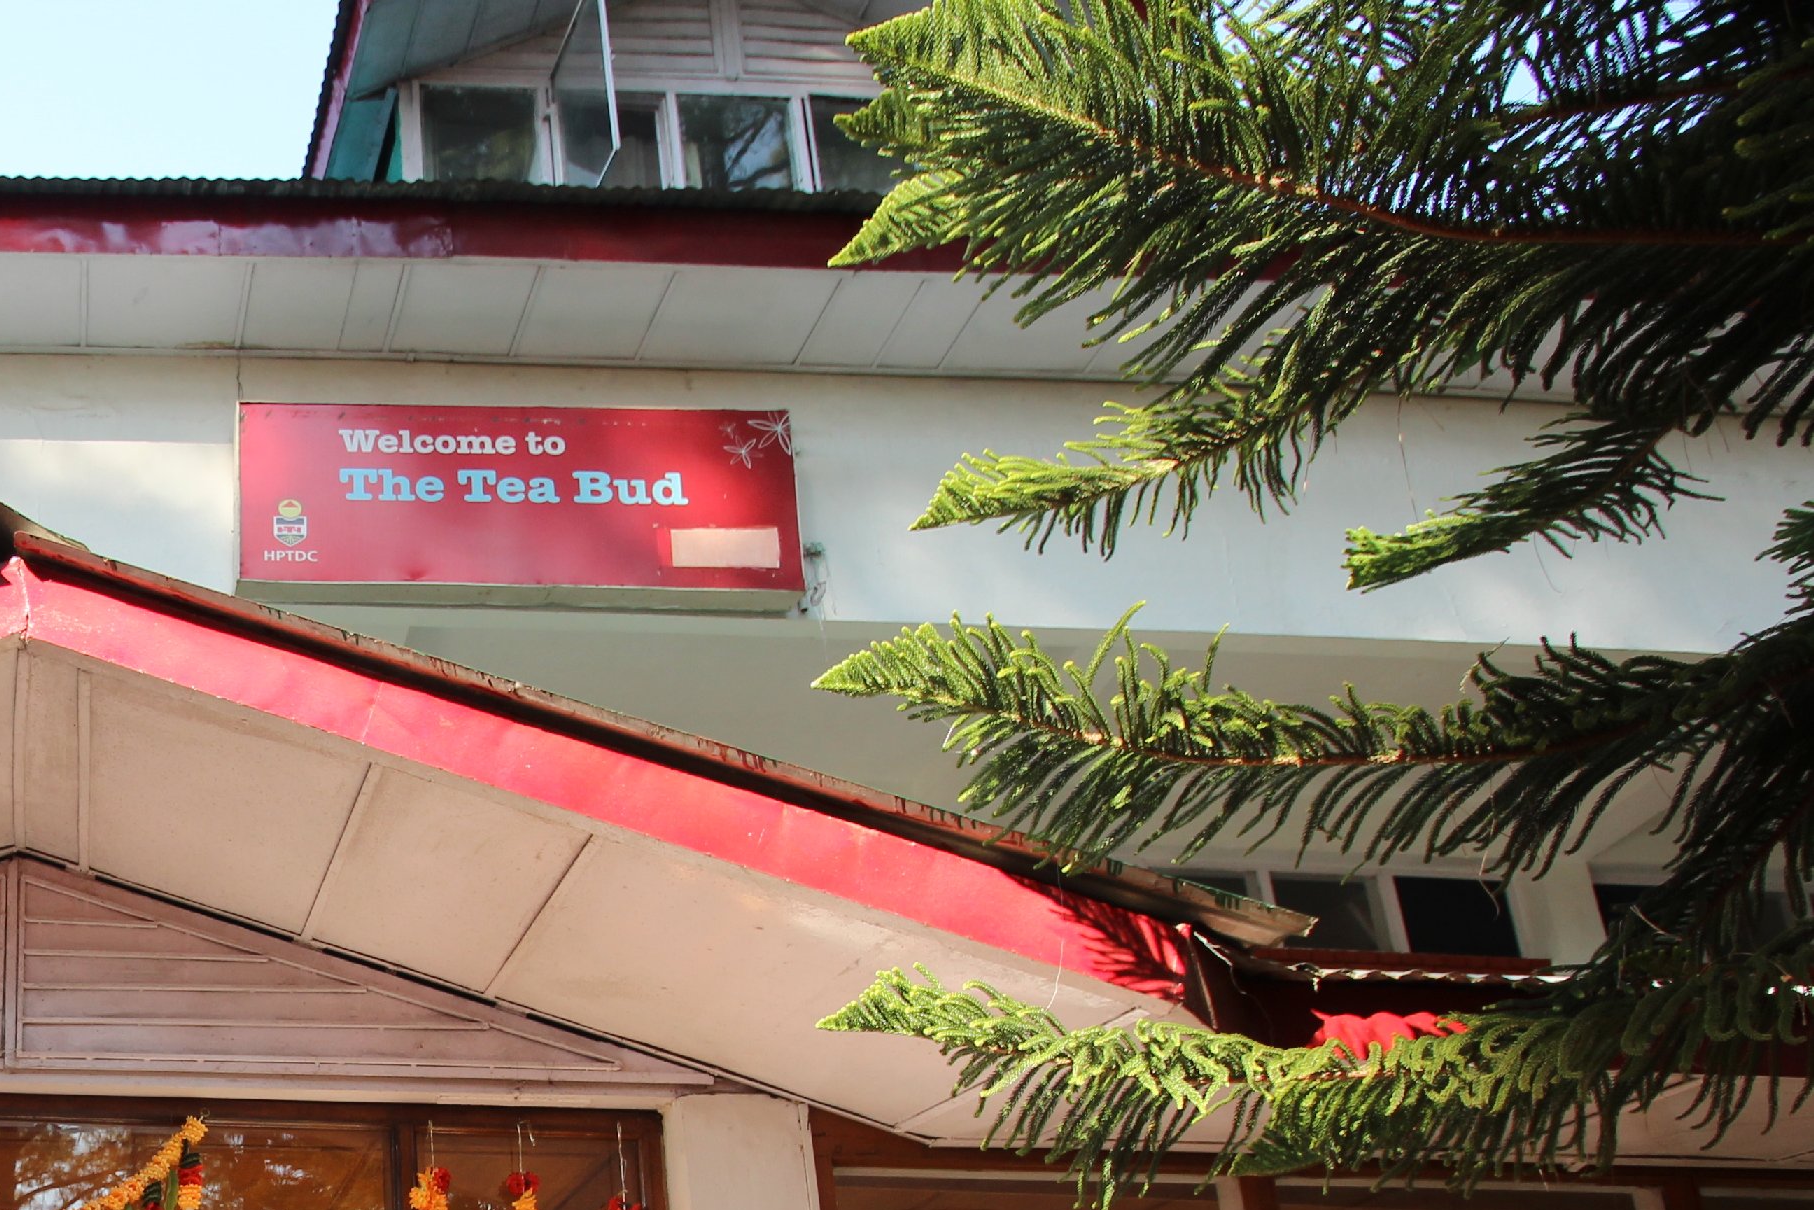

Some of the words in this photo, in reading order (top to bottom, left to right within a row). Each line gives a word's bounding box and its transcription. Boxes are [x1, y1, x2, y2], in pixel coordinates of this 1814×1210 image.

[338, 429, 517, 456] Welcome
[524, 431, 566, 456] to
[338, 468, 445, 502] The
[457, 469, 561, 503] Tea
[571, 470, 689, 505] Bud
[263, 550, 319, 562] HPTDC
